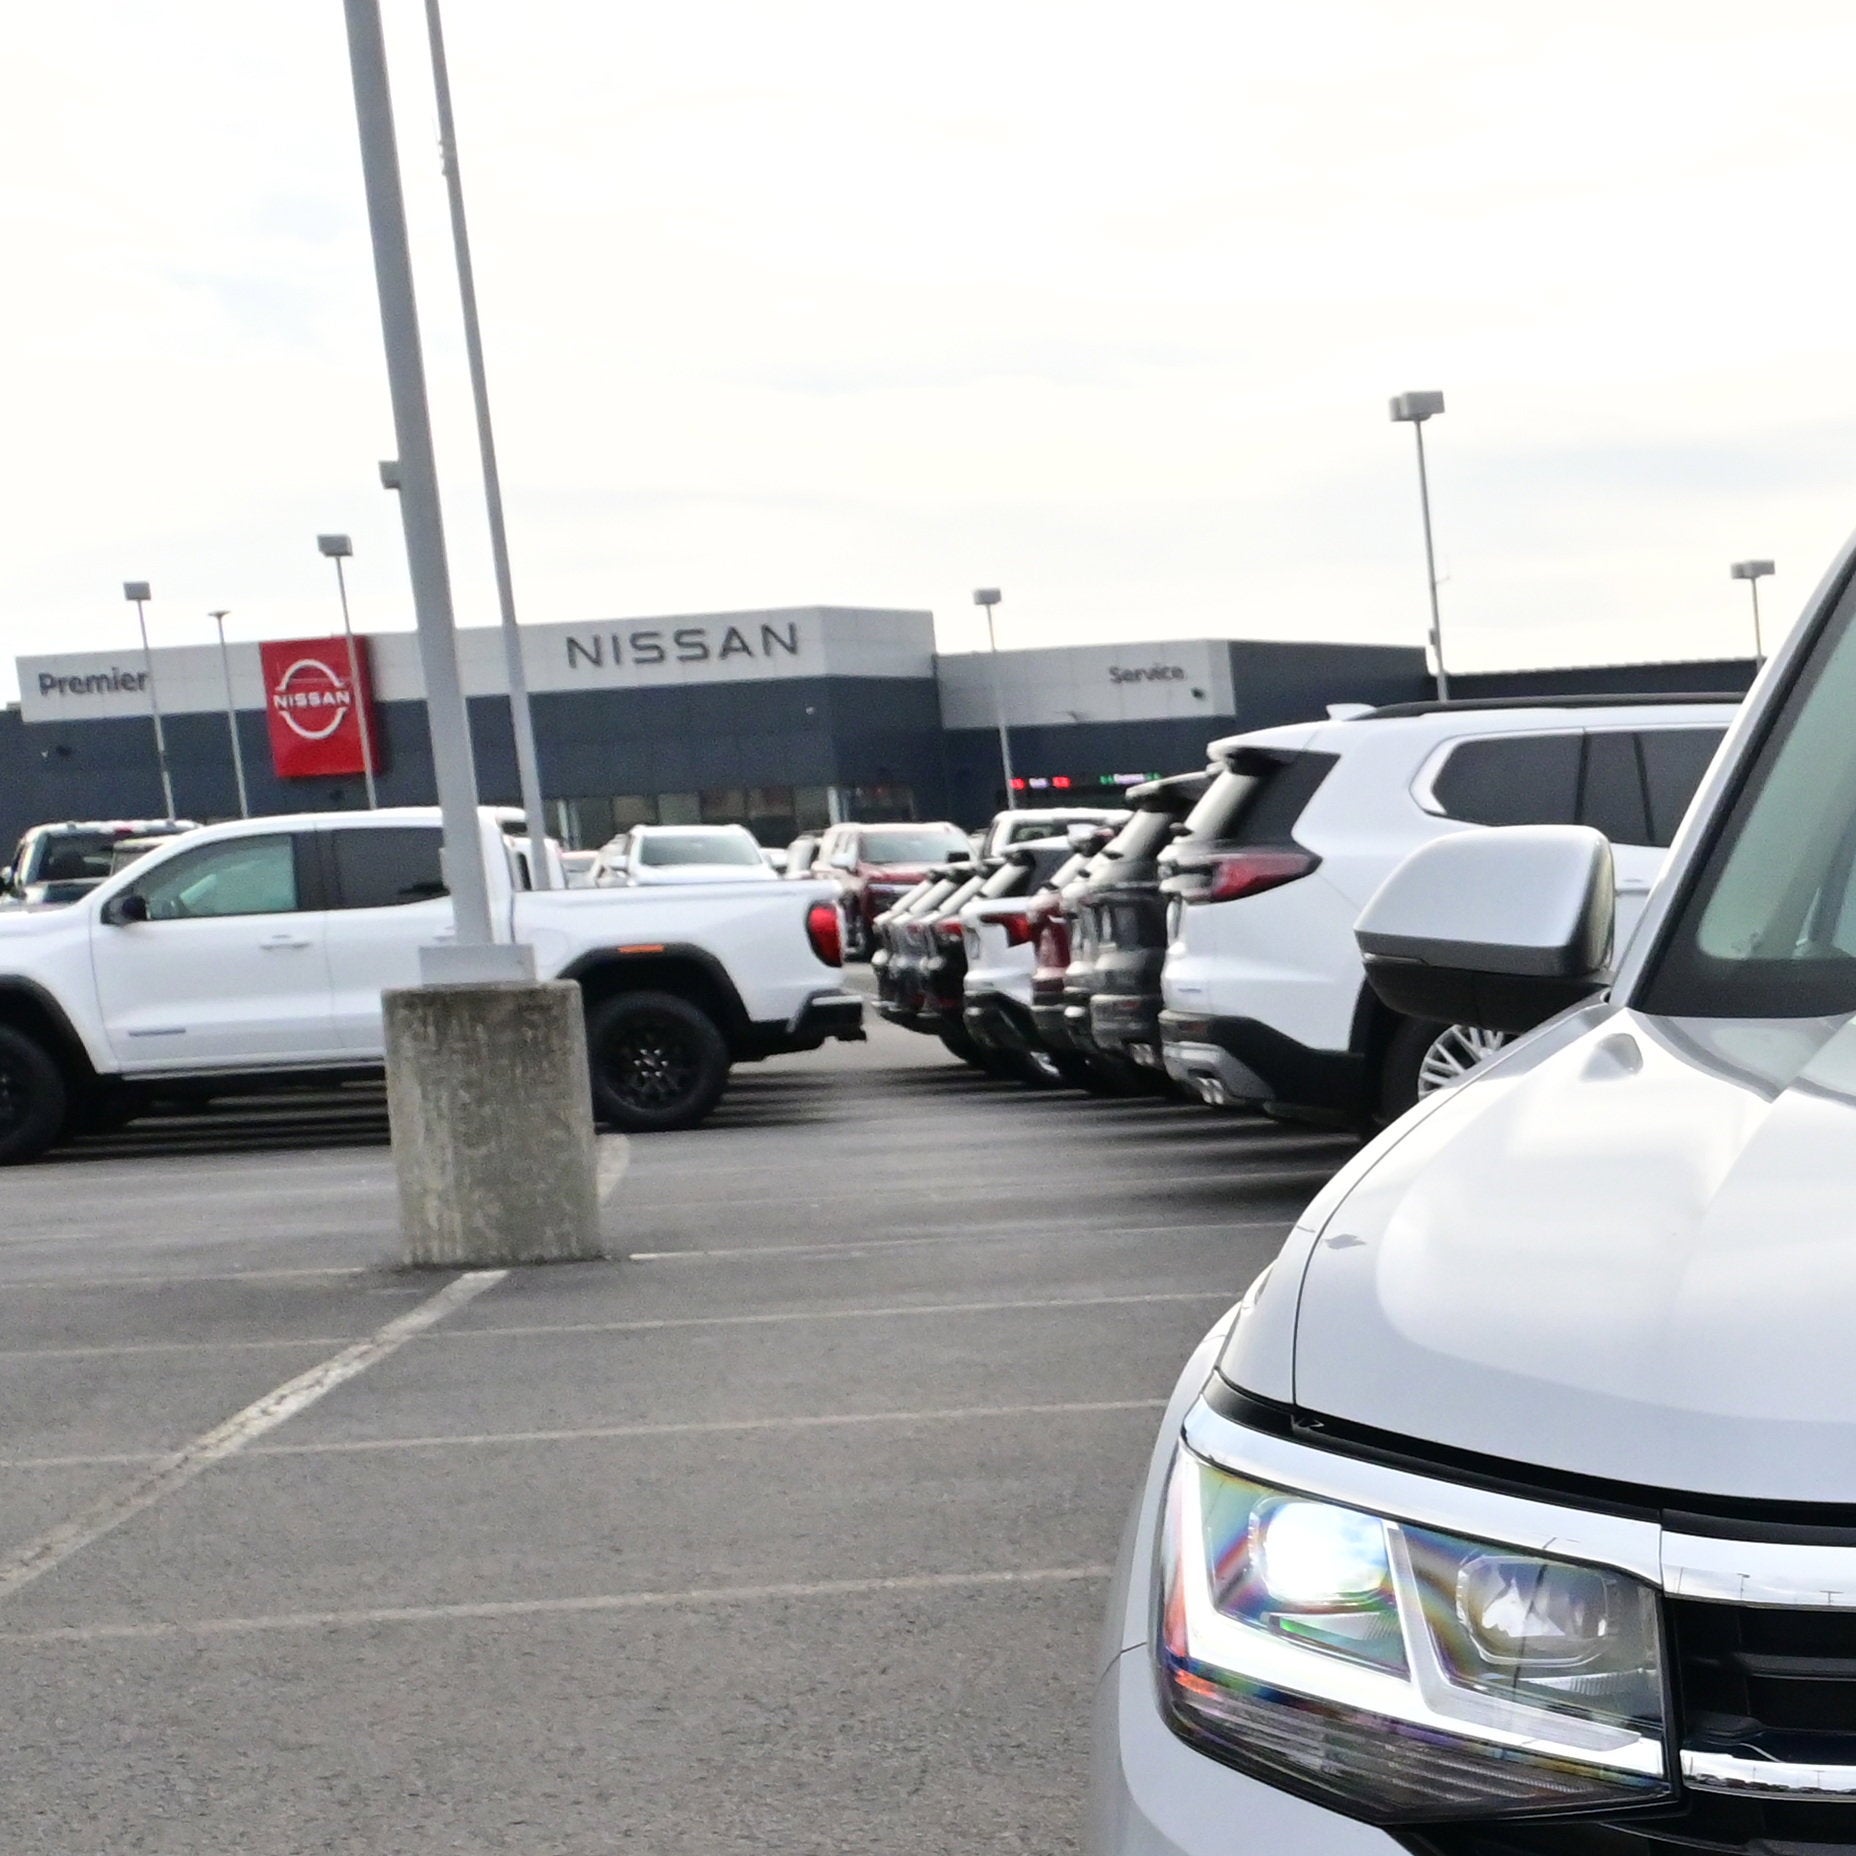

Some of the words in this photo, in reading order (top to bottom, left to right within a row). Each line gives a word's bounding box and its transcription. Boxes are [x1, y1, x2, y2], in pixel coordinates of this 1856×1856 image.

[566, 621, 799, 669] NISSAN
[38, 666, 148, 696] Premier
[1109, 666, 1184, 684] Service
[273, 691, 350, 708] NISSAN
